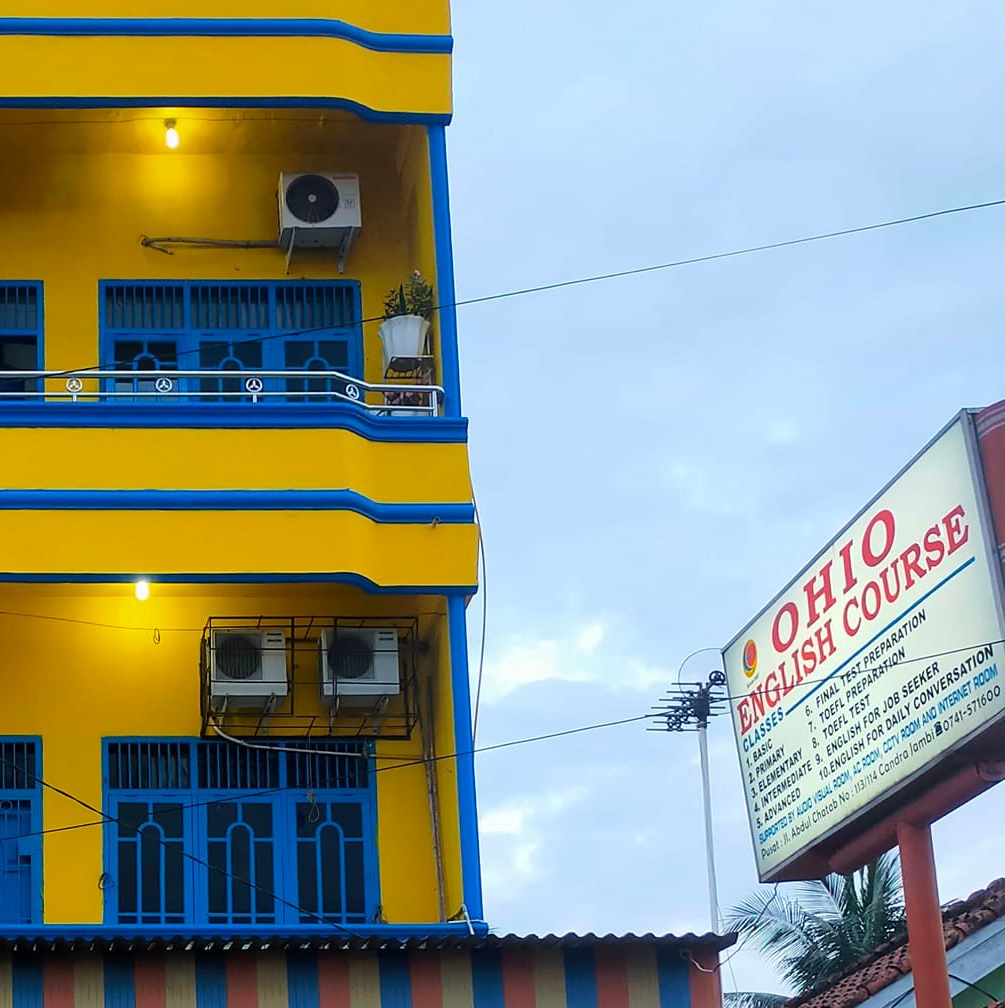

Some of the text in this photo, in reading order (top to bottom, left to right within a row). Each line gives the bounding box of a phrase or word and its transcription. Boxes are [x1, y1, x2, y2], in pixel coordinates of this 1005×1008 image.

[771, 509, 895, 653] OHIO
[736, 504, 969, 736] ENGLISH COURSE
[816, 608, 926, 709] FINAL TEST PREPARATION
[819, 646, 906, 724] TOEFL PREPARATION
[822, 693, 871, 740] TOEFL TEST
[826, 661, 940, 757] ENGLISH FOR JOB SEEKER
[866, 643, 994, 746] FOR DAILY CONVERSATION
[922, 706, 937, 728] AND
[937, 680, 972, 711] INTERNET
[973, 663, 998, 690] ROOM
[741, 706, 784, 752] CLASSES
[752, 738, 773, 762] BASIC
[755, 744, 786, 778] PRIMARY
[758, 748, 803, 792] ELEMENTARY
[761, 760, 813, 808] INTERMEDIATE
[791, 817, 812, 839] Abdul
[838, 792, 850, 806] No
[854, 770, 878, 795] 113/114
[878, 750, 908, 776] Candra
[909, 728, 935, 756] Jambi
[943, 685, 1001, 732] 0741-571600
[764, 787, 801, 824] ADVANCED
